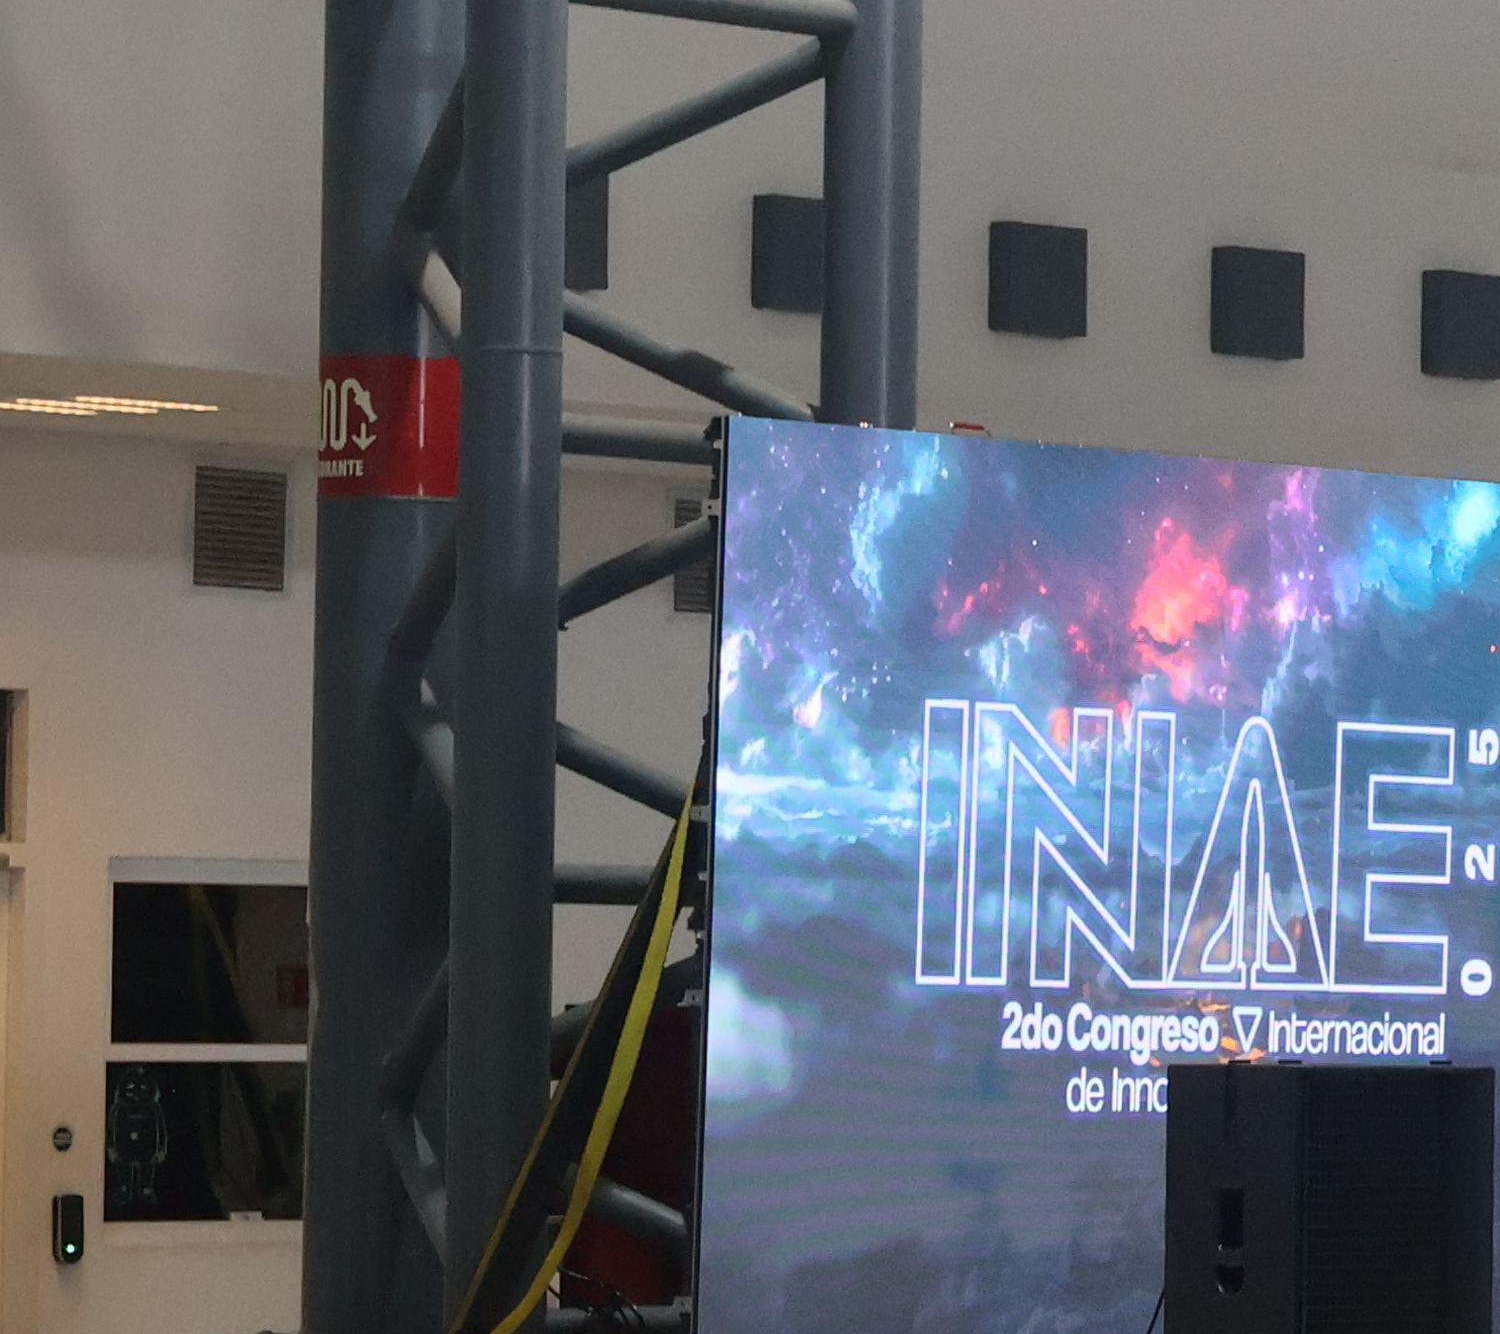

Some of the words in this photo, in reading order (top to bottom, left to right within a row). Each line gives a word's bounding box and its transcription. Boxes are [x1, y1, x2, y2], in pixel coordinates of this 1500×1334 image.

[1001, 1001, 1064, 1051] 2do
[1066, 1002, 1219, 1066] Congreso
[1267, 1011, 1446, 1056] Internacional
[1066, 1068, 1104, 1113] de
